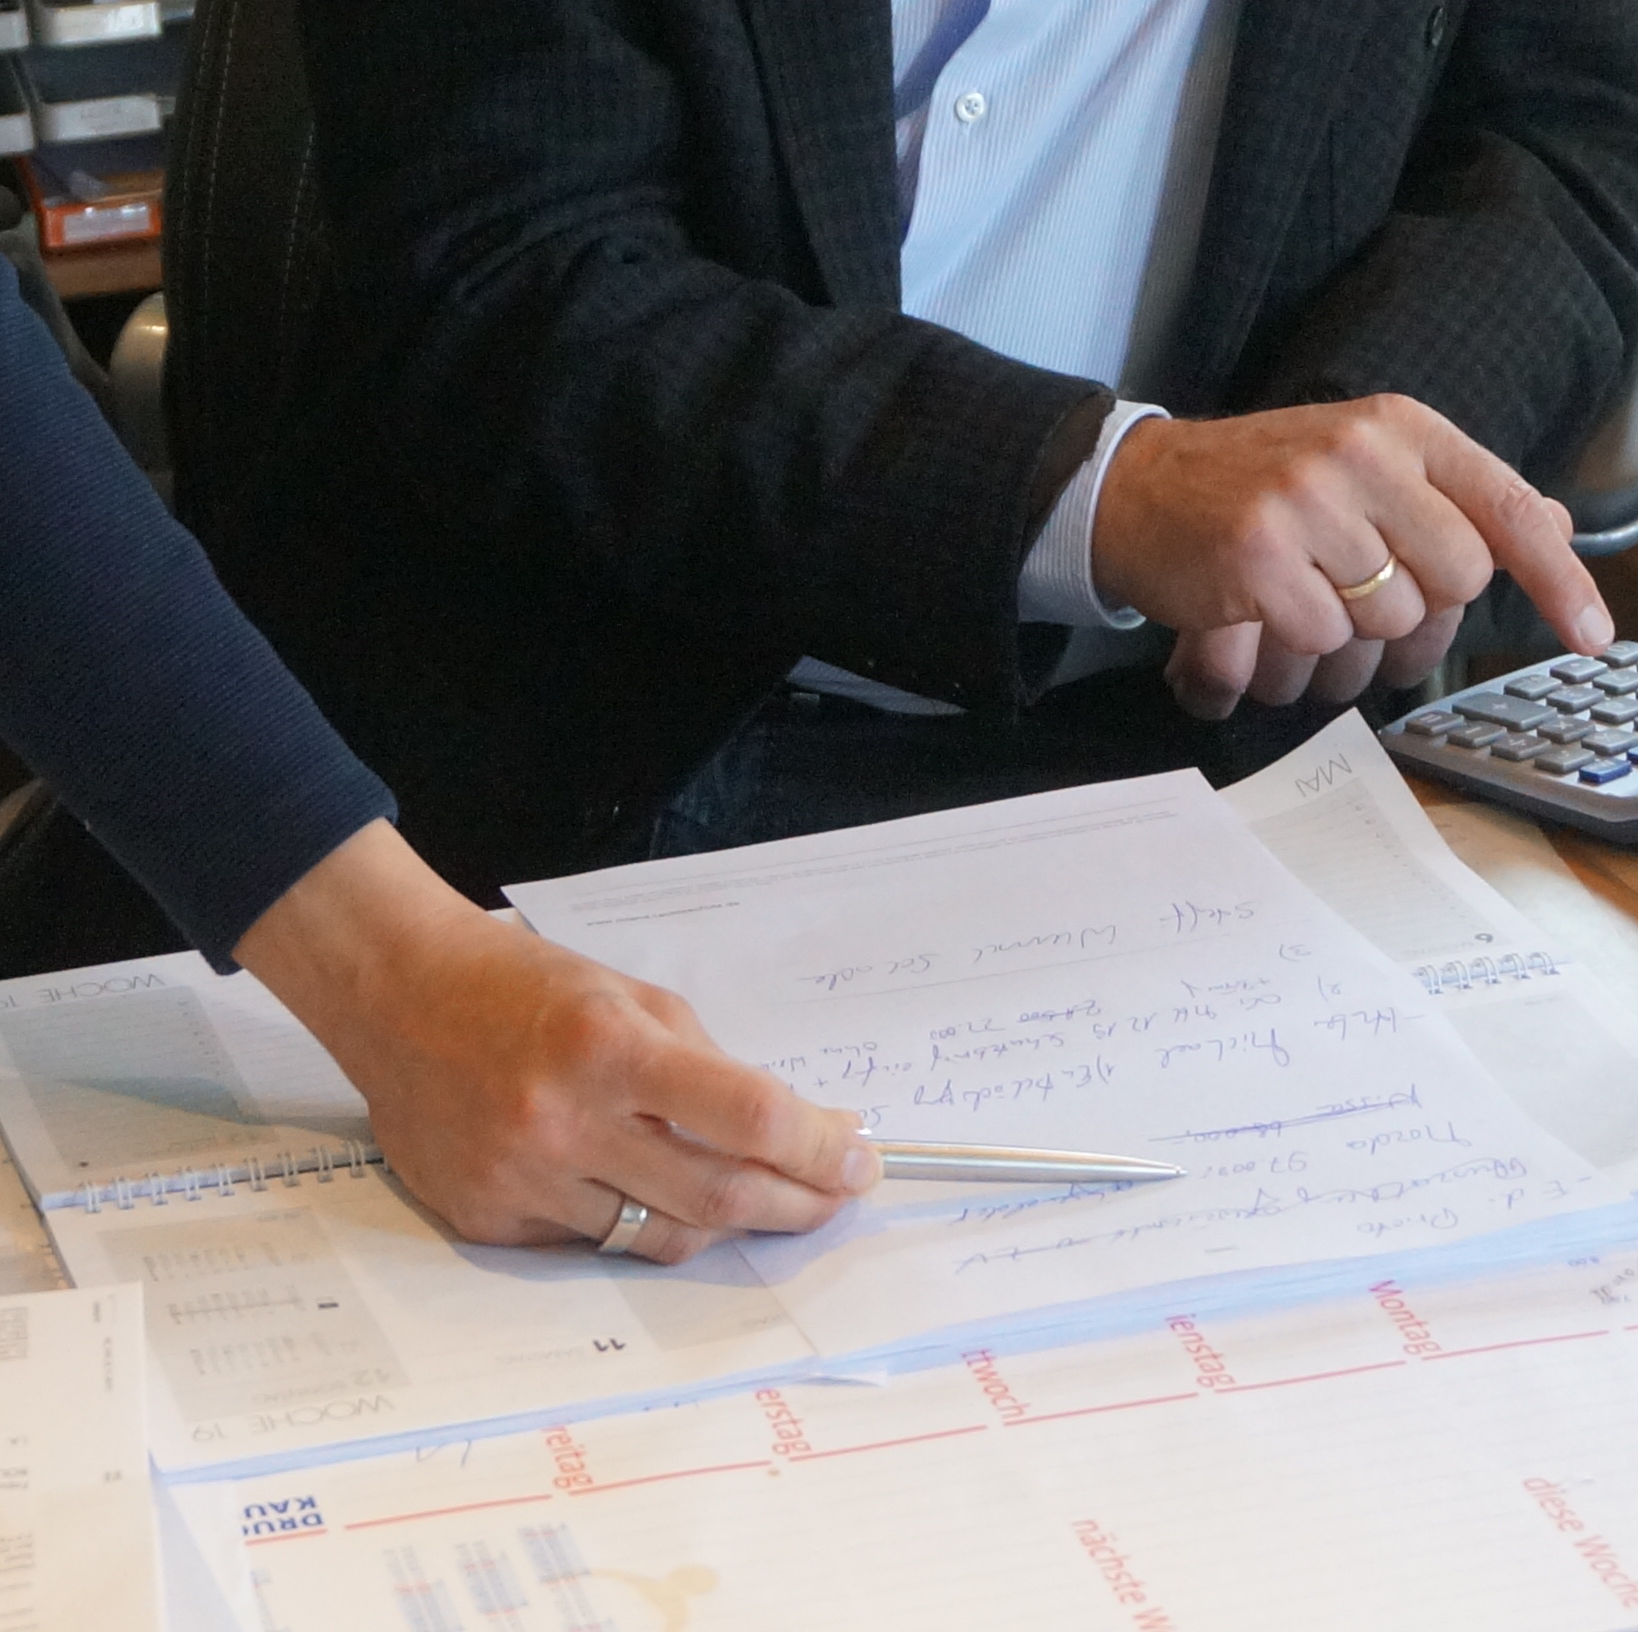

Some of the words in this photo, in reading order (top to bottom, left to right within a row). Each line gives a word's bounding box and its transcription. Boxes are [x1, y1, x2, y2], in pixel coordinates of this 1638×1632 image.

[1294, 753, 1353, 798] MAI
[38, 973, 166, 1006] WOCHE
[592, 1337, 626, 1352] 11
[1369, 1279, 1441, 1358] Montag
[1165, 1311, 1235, 1389] ienstag
[250, 1394, 395, 1437] WOCHE
[960, 1348, 1033, 1425] ttwoch
[192, 1424, 226, 1442] 19
[754, 1386, 812, 1456] erstag
[540, 1424, 594, 1488] reitag
[1522, 1475, 1587, 1535] diese
[1071, 1517, 1147, 1606] nächste
